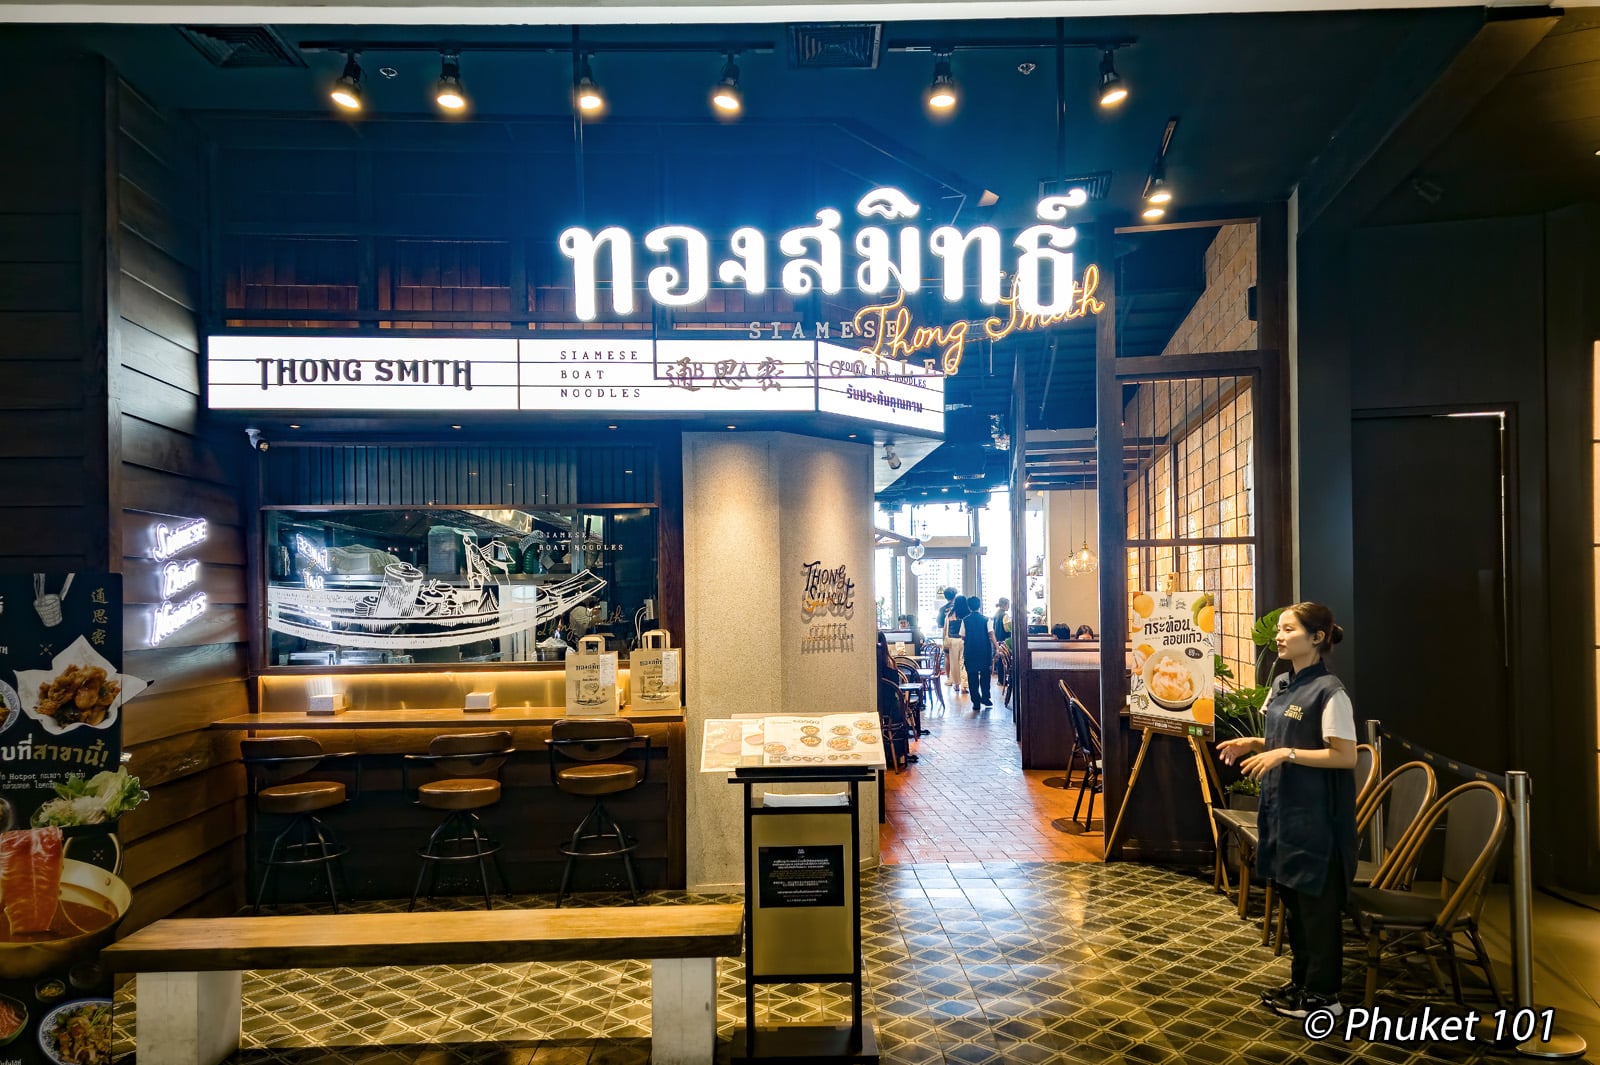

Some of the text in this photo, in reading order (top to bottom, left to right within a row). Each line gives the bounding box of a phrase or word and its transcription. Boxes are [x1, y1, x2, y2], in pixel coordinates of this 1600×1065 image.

[559, 188, 1087, 321] ทองสมิทธ์
[749, 321, 898, 339] SIAMESE
[854, 287, 968, 373] Thong
[560, 350, 638, 361] SIAMESE
[256, 358, 473, 391] THONG SMITH
[560, 369, 605, 380] BOAT
[806, 358, 958, 377] NOODLES
[560, 388, 641, 399] NOODLES
[1144, 615, 1192, 636] กระท้อน
[1162, 629, 1203, 647] ลอยแก้ว
